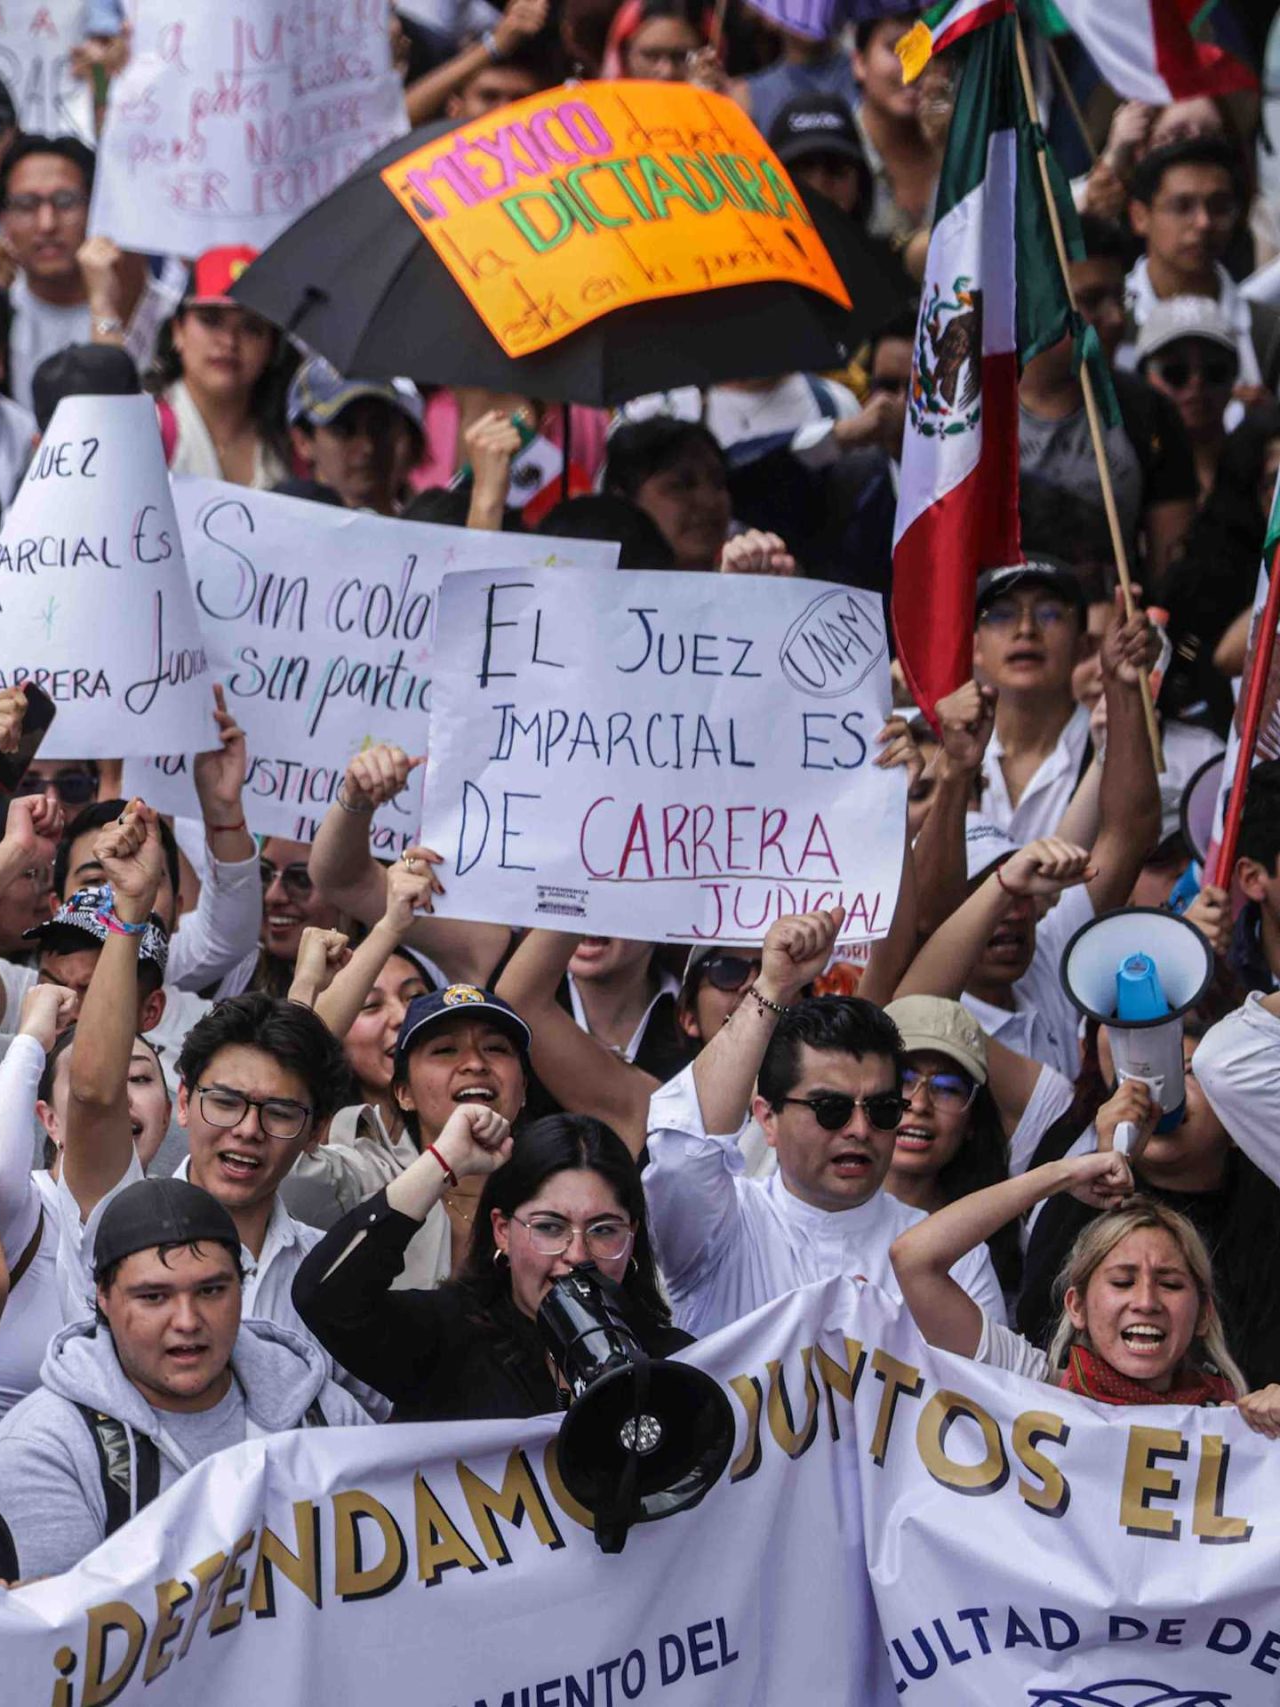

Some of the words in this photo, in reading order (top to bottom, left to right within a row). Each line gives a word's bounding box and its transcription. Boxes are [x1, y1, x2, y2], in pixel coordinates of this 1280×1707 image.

[28, 5, 58, 38] A
[500, 151, 812, 253] DICTADURA
[196, 500, 308, 633] Sin
[328, 553, 440, 641] colo
[477, 582, 566, 689] EL
[616, 607, 762, 678] JUEZ
[784, 595, 882, 690] UNAM
[489, 703, 756, 770] IMPARCIAL
[801, 711, 869, 771] ES
[455, 780, 542, 878] DE
[579, 796, 840, 879] CARRERA
[51, 1436, 598, 1707] ¡DEFENDAM
[729, 1338, 1070, 1518] JUNTOS
[1120, 1424, 1255, 1546] EL
[657, 1616, 740, 1687] DEL
[886, 1605, 1081, 1695] ULTAD
[1108, 1614, 1187, 1646] DE
